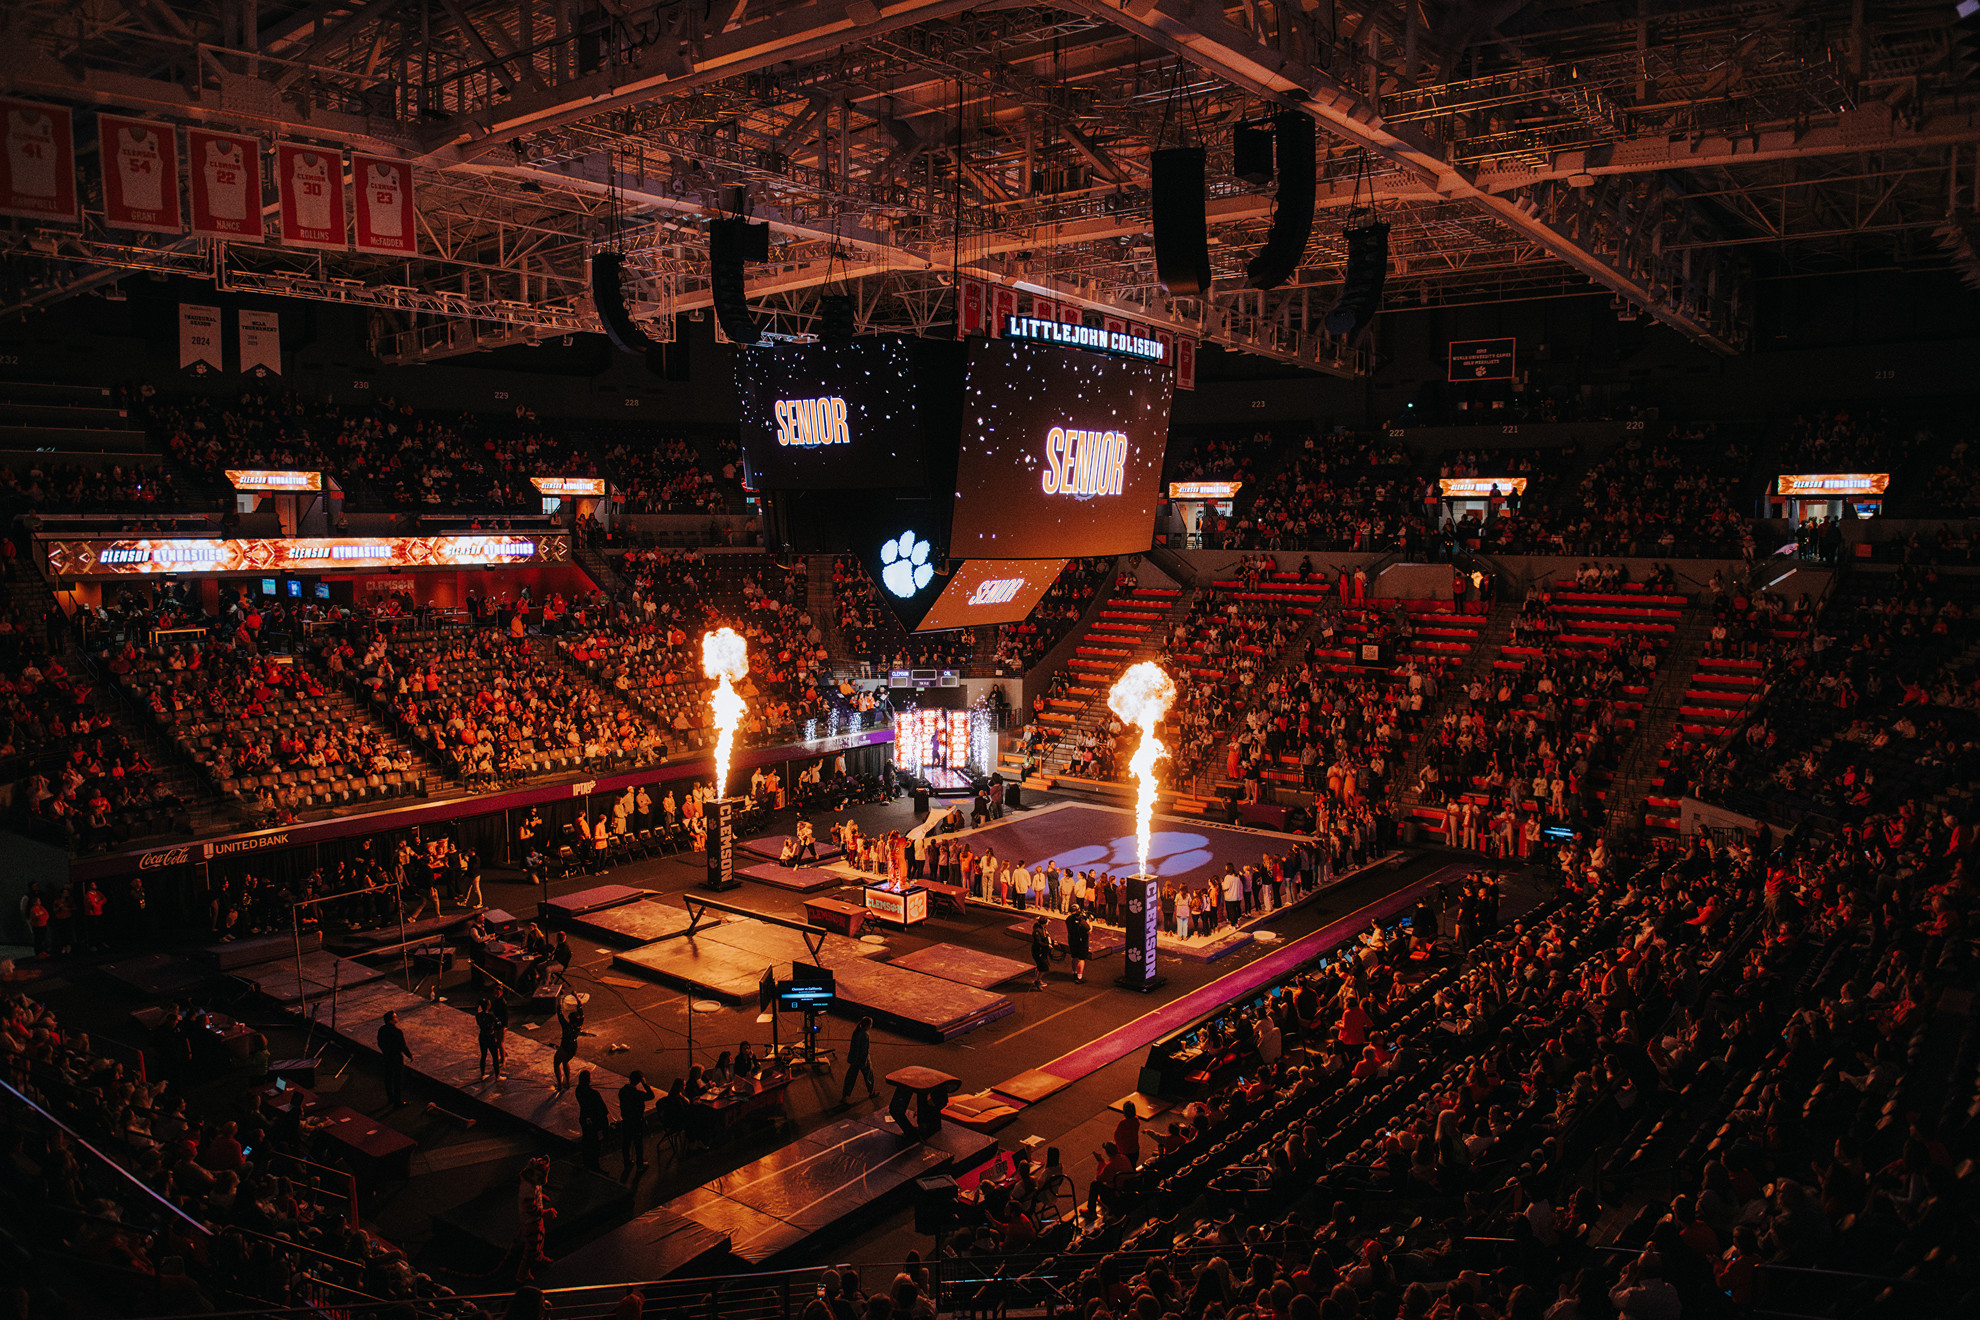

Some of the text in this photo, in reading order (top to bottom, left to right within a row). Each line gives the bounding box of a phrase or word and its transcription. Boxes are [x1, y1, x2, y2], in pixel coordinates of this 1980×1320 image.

[130, 158, 152, 174] 54
[209, 161, 241, 171] CLEMSON
[216, 171, 237, 186] 22
[297, 173, 326, 183] CLEMSON
[303, 182, 322, 197] 30
[370, 182, 398, 191] CLEMSON
[376, 192, 393, 205] 23
[131, 210, 157, 223] GRANT
[216, 219, 241, 232] NANCE
[300, 228, 330, 242] ROLLINS
[370, 236, 404, 248] McFADDEN
[191, 336, 211, 346] 2024
[1009, 316, 1165, 360] LITTLEJOHN COLISEUM
[1873, 370, 1896, 380] 219
[353, 380, 370, 390] 230
[494, 390, 509, 400] 229
[624, 398, 640, 407] 228
[1251, 400, 1265, 408] 223
[774, 397, 851, 446] SENIOR
[1625, 420, 1644, 431] 220
[1389, 428, 1405, 438] 222
[1502, 424, 1518, 434] 221
[1042, 427, 1128, 496] SENIOR
[240, 475, 308, 486] CLEMSON GYMNASTICS
[1793, 479, 1872, 489] CLEMSON GYMNASTICS
[100, 548, 224, 563] CLEMSON GYMNASTICS
[288, 545, 393, 559] CLEMSON GYMNASTICS
[447, 542, 535, 556] CLEMSON GYMNASTICS
[968, 578, 1025, 606] SENIOR
[215, 833, 289, 855] UNITED BANK
[720, 804, 734, 883] CLEMSON
[138, 847, 191, 870] Coca-Cola
[807, 908, 846, 927] CLEMSON
[1144, 881, 1158, 980] CLEMSON
